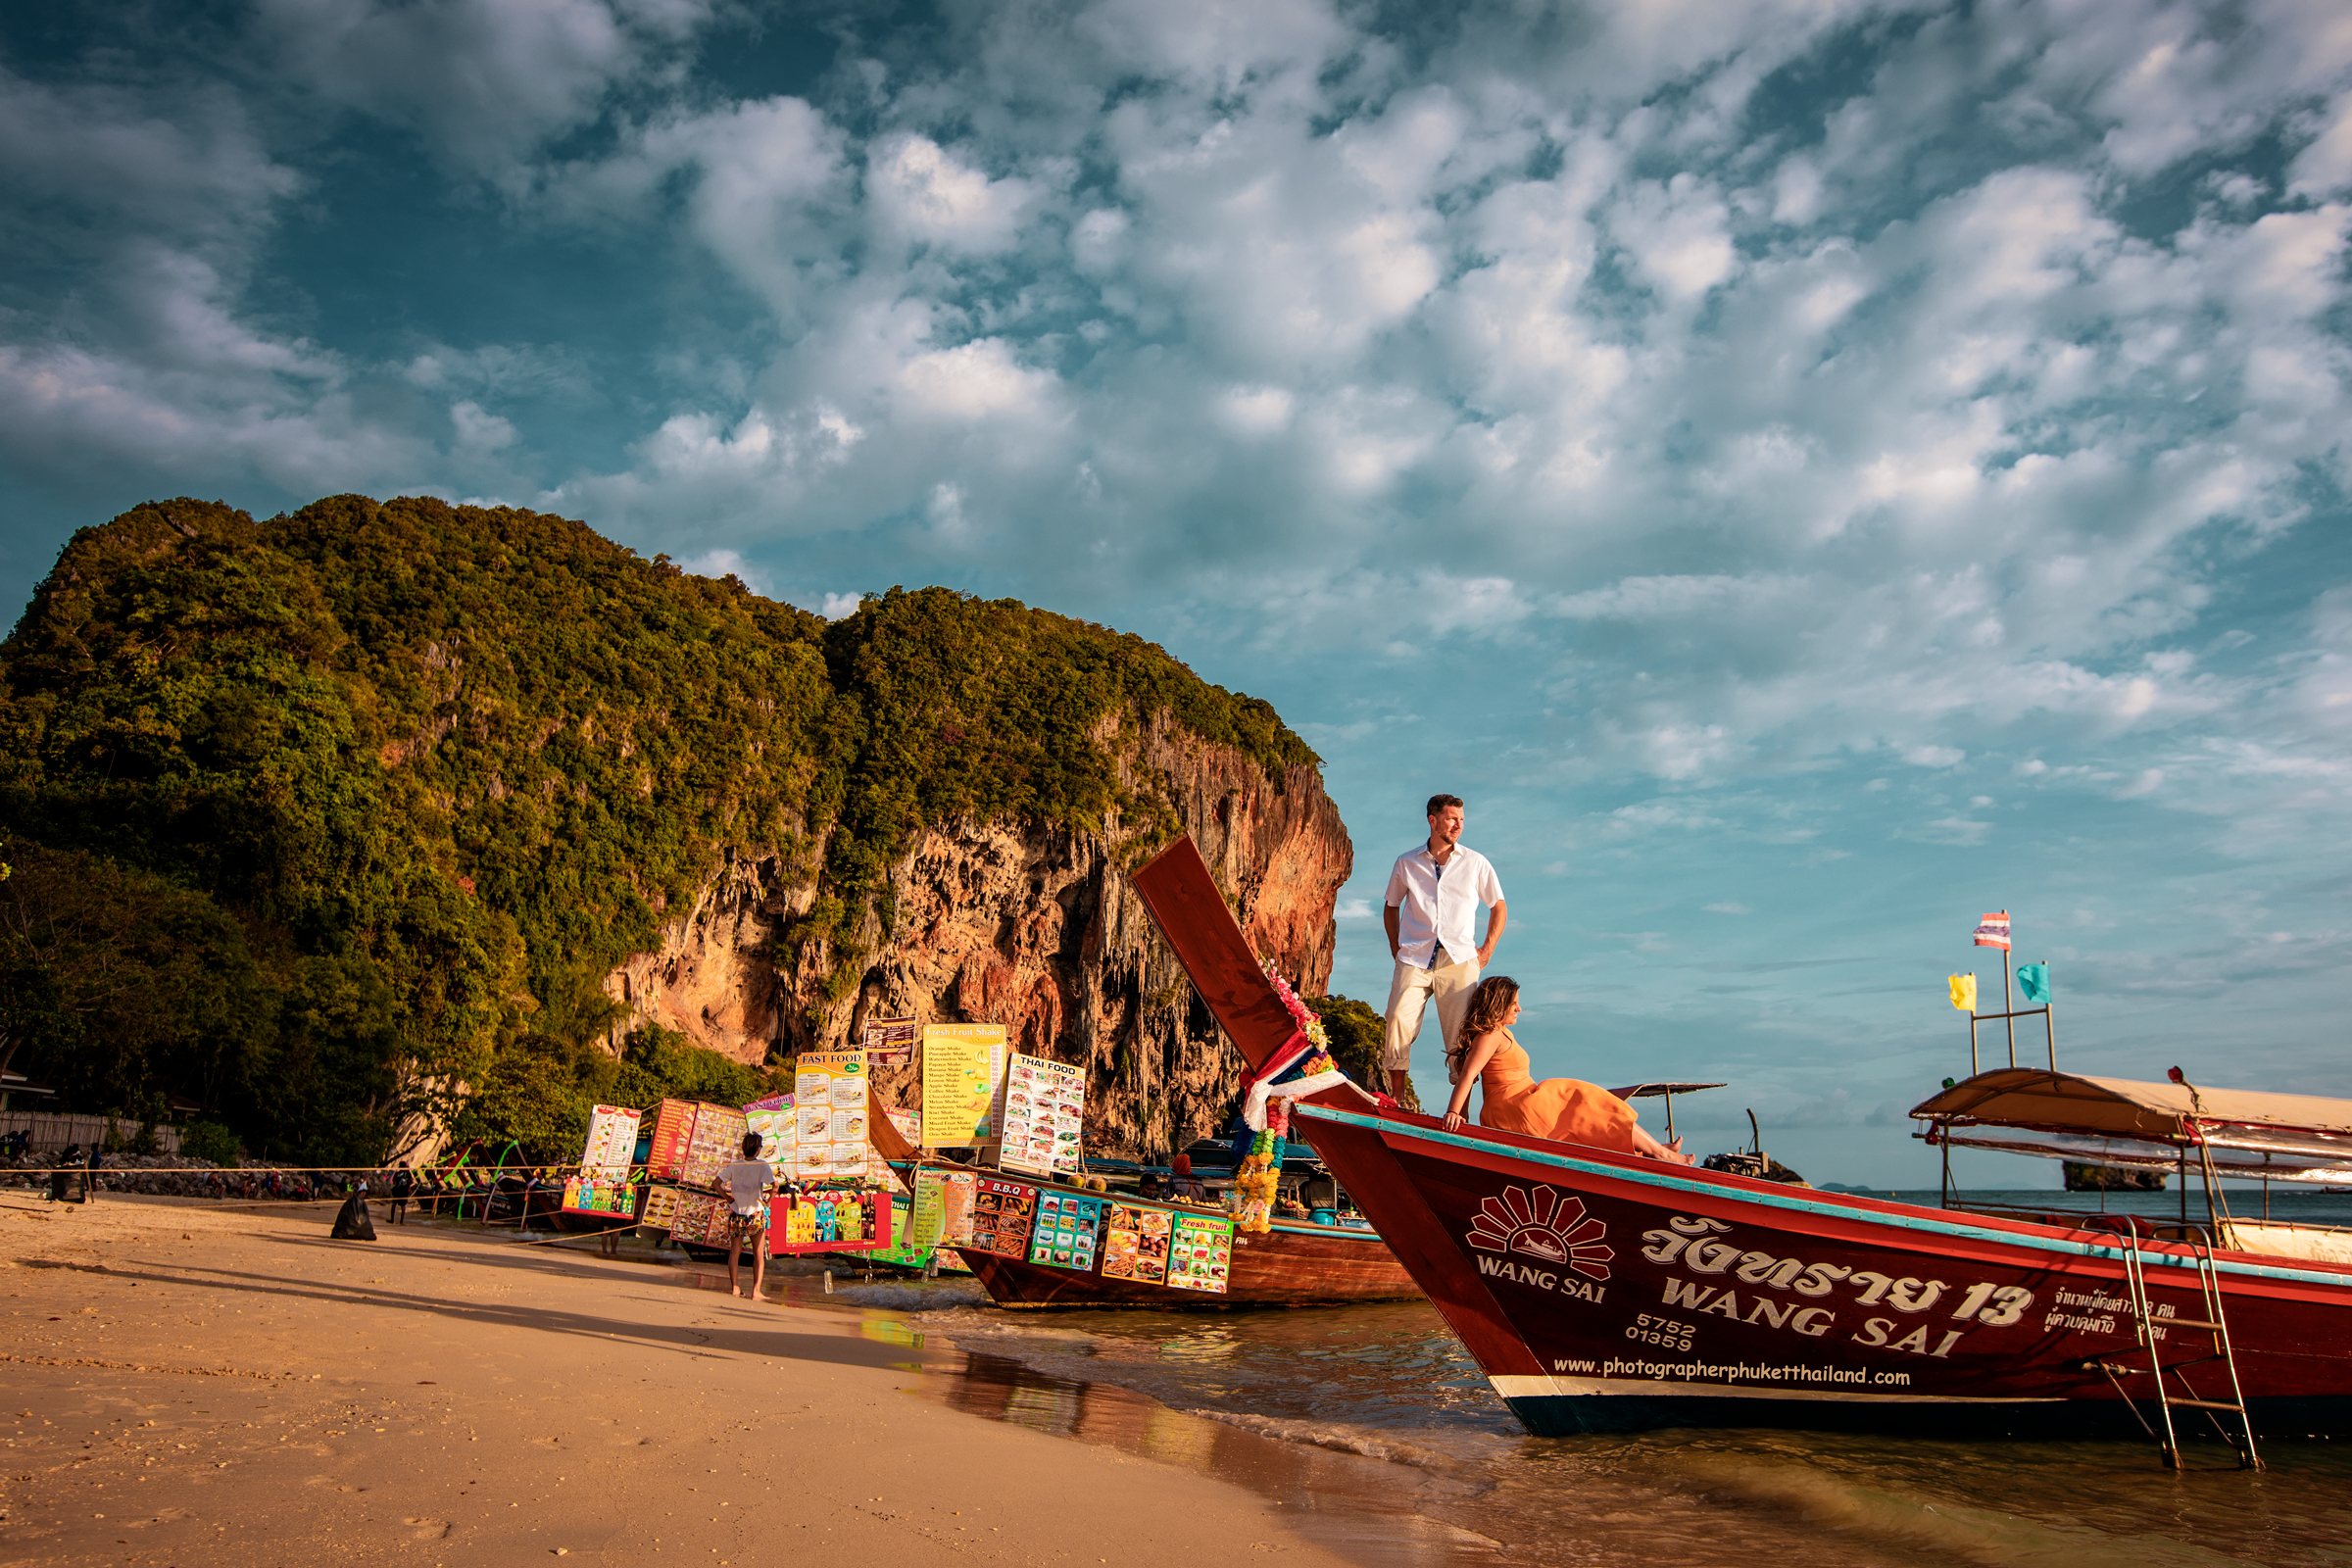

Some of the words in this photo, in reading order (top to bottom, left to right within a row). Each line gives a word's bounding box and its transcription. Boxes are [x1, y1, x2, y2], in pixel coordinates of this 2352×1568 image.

[926, 1028, 950, 1036] Fresh
[953, 1028, 972, 1036] Fruit
[976, 1027, 1001, 1036] Shake
[802, 1055, 827, 1063] FAST
[831, 1054, 861, 1063] FOOD
[1021, 1056, 1045, 1068] THAI
[1048, 1063, 1076, 1075] FOOD
[748, 1102, 766, 1112] FAST
[769, 1096, 791, 1106] FOOD
[890, 1108, 907, 1116] Food
[992, 1182, 1021, 1195] B.B.Q
[1181, 1218, 1206, 1228] Fresh
[1209, 1222, 1228, 1231] fruit
[1476, 1255, 1557, 1290] WANG
[1560, 1278, 1606, 1304] SAI
[1641, 1216, 1952, 1314] วังทราย
[1950, 1282, 2034, 1327] 13
[1661, 1277, 1836, 1337] WANG
[1851, 1318, 1963, 1359] SAI
[2156, 1303, 2175, 1318] คน
[1636, 1313, 1697, 1338] 5752
[1625, 1327, 1692, 1352] 01359
[1554, 1356, 1911, 1385] www.photographerphuketthailand.com
